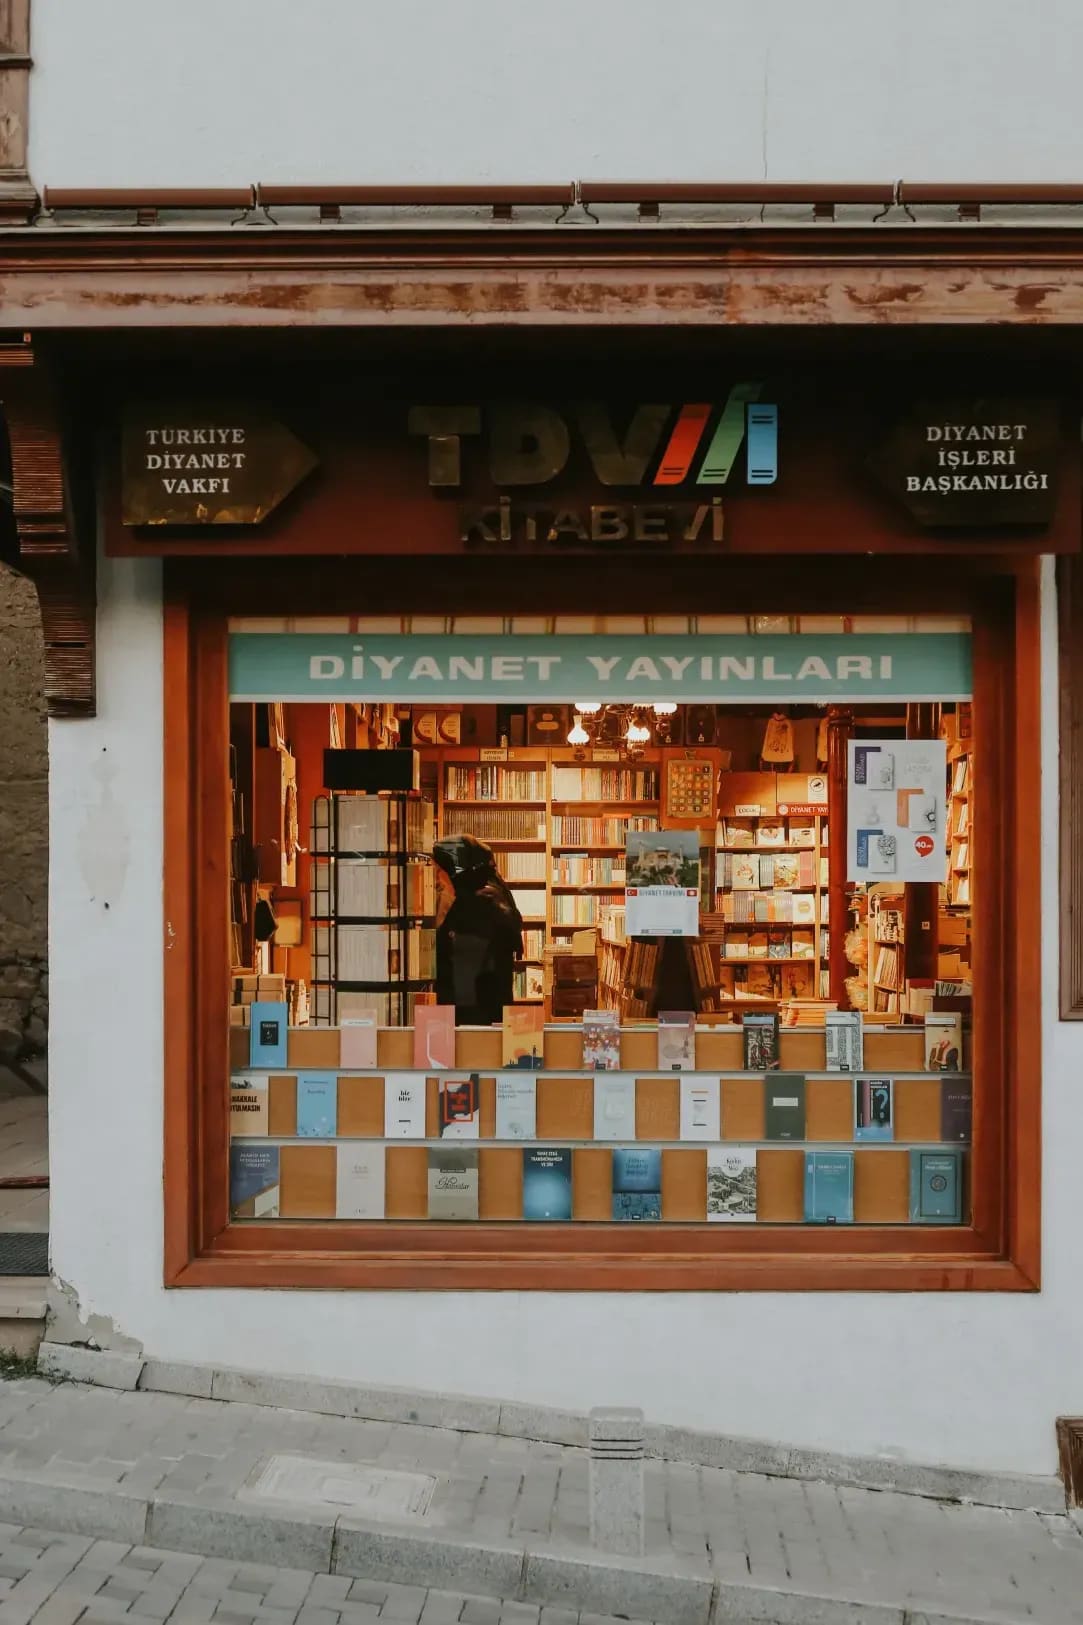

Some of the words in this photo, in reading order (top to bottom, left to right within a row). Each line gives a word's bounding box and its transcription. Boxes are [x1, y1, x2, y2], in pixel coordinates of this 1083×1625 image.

[926, 422, 1027, 441] DİYANET
[146, 450, 246, 469] DİYANET
[938, 446, 1016, 470] İŞLERİ
[162, 478, 230, 494] VAKFI
[906, 470, 1048, 495] BAŞKANLIĞI
[309, 645, 562, 681] DİYANET
[587, 655, 893, 681] YAYINLARI
